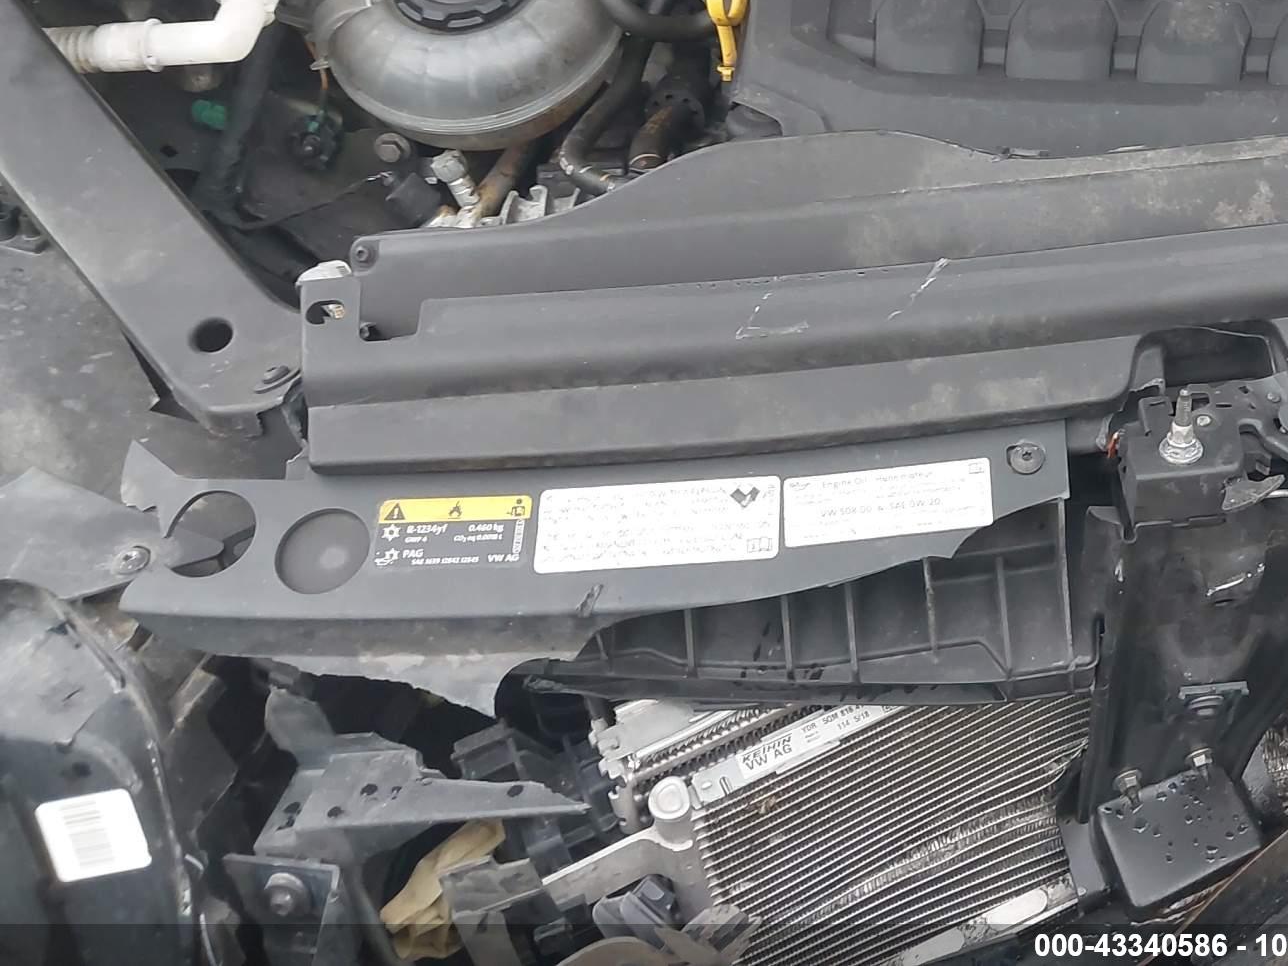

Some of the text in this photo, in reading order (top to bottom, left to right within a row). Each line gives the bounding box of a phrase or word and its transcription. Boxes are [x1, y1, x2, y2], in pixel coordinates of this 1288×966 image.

[402, 548, 424, 558] PAG
[488, 553, 520, 563] VW AG
[742, 736, 792, 764] KEIHIN
[745, 743, 792, 770] VW AG
